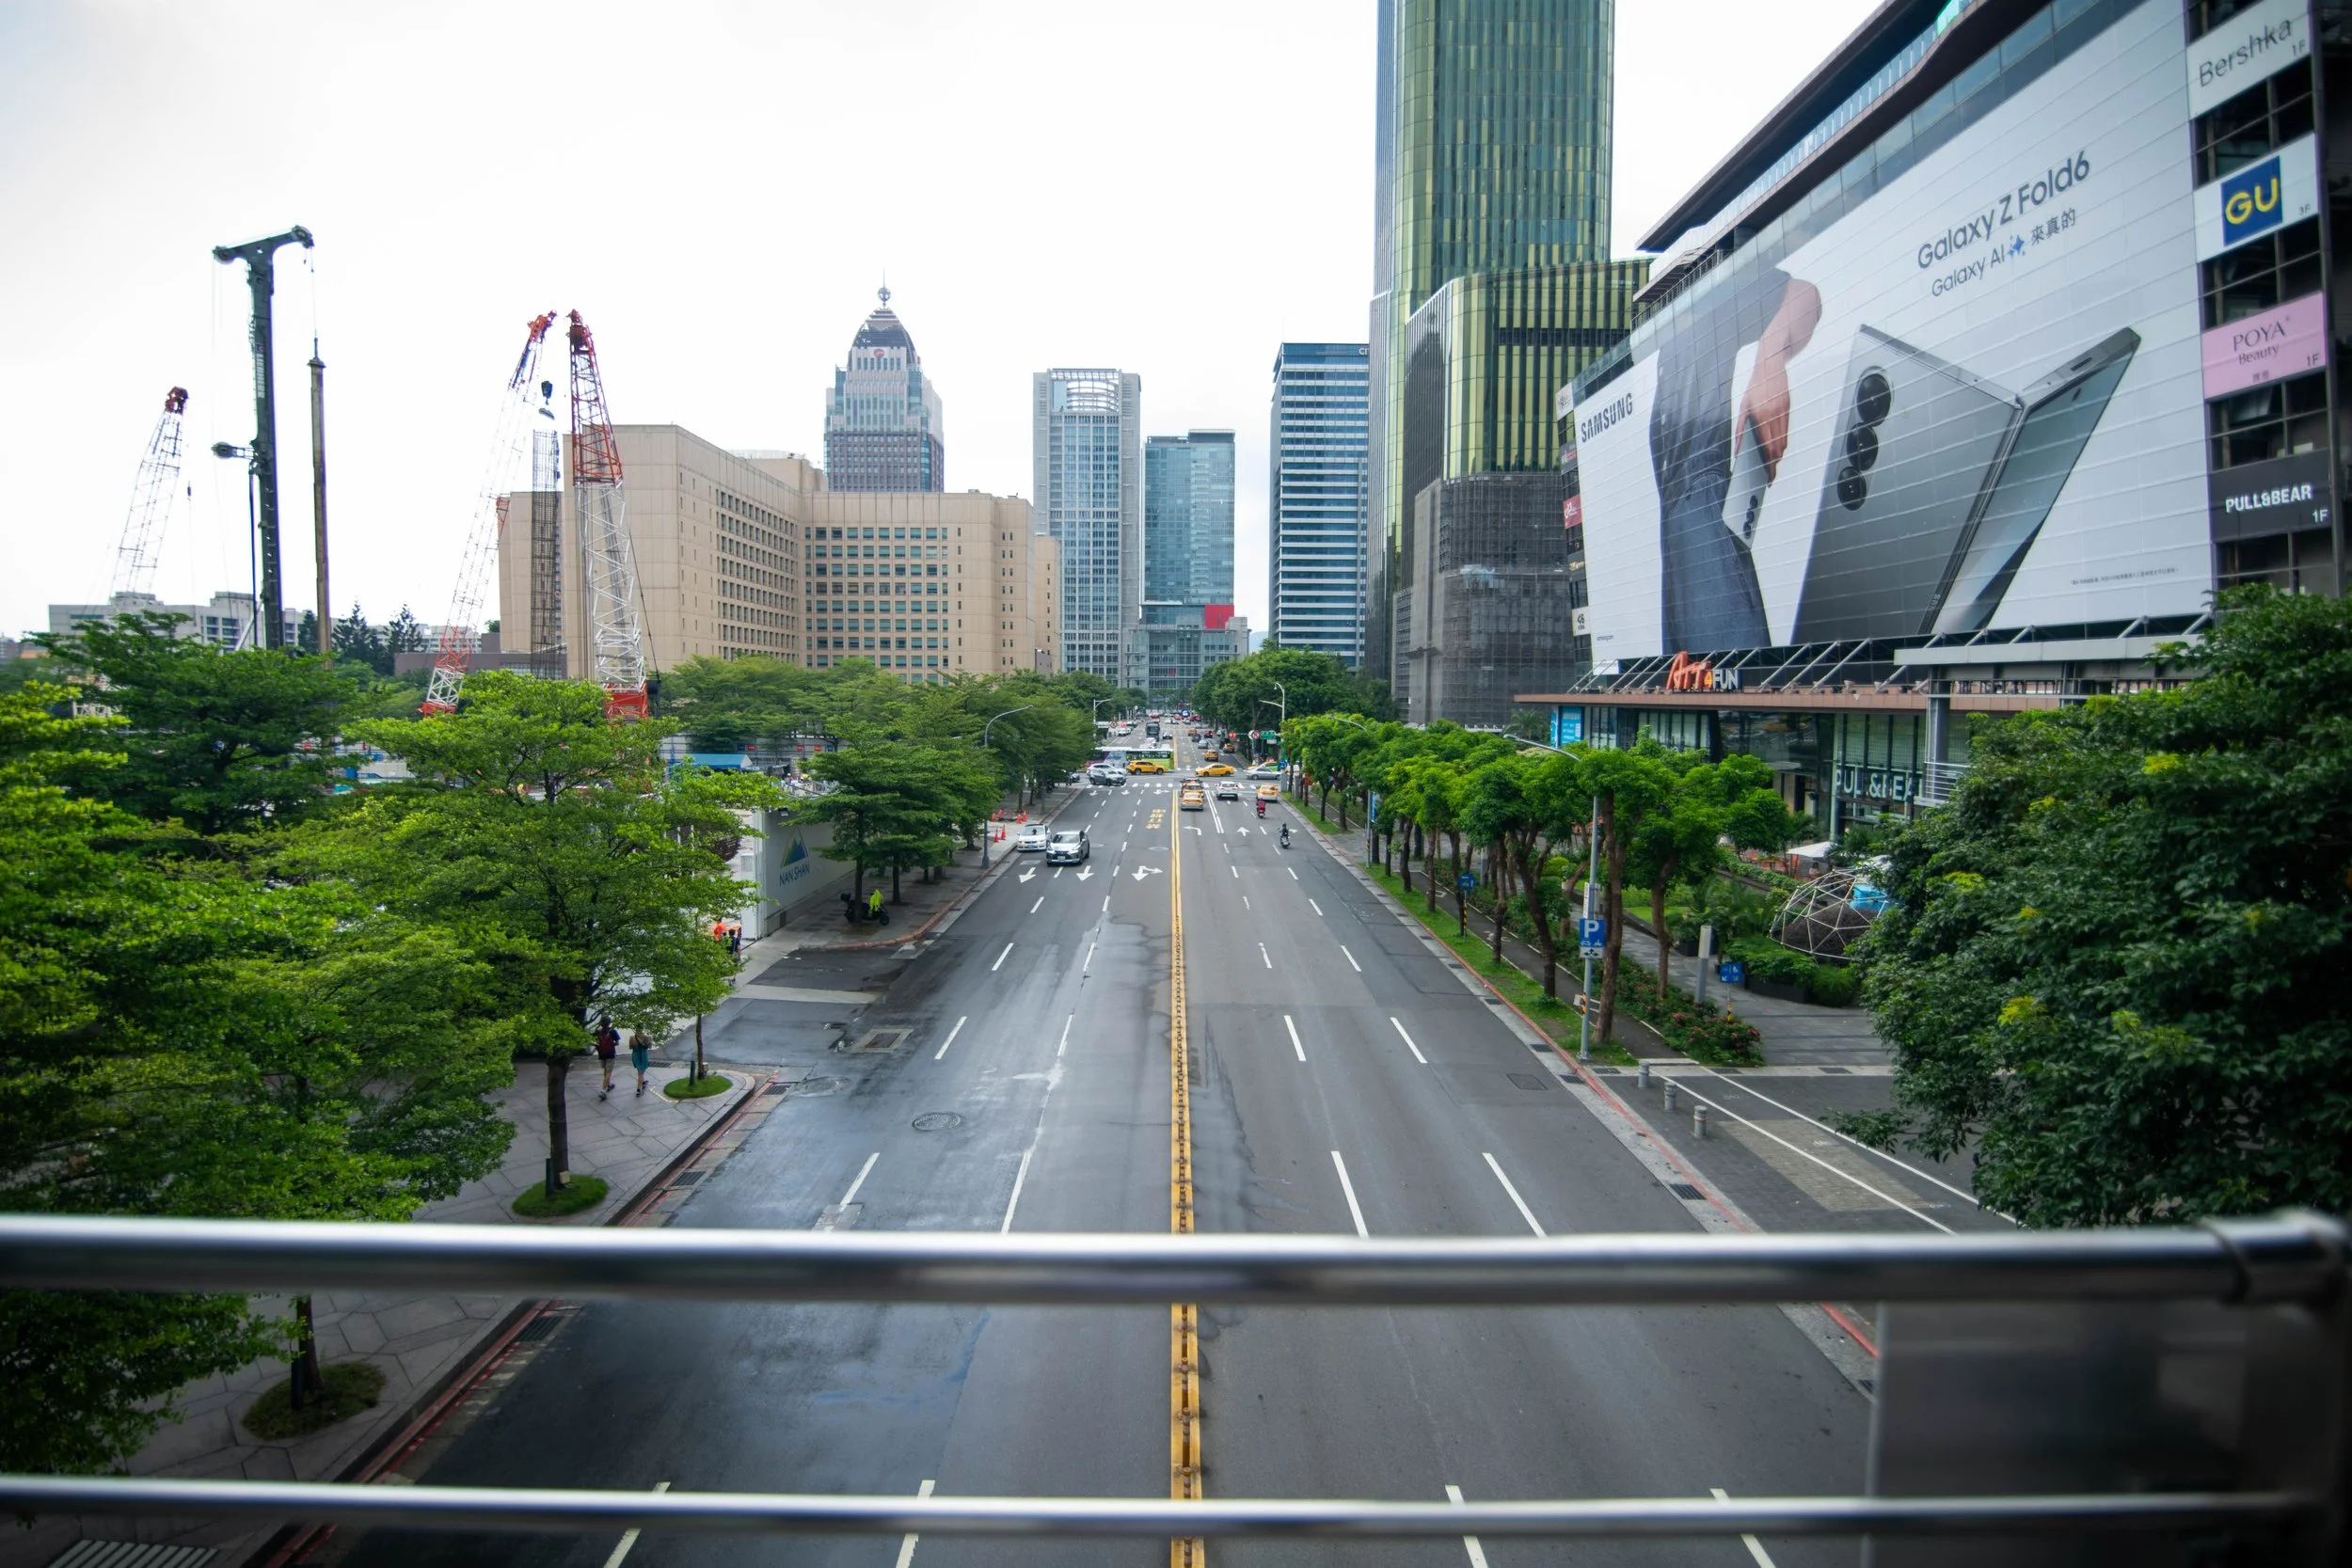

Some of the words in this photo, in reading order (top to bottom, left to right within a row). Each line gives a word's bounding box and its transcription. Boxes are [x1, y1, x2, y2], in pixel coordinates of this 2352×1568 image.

[2199, 19, 2292, 87] Bershka
[2291, 40, 2306, 56] 1F
[1917, 208, 1995, 270] Galaxy
[1998, 194, 2013, 226] Z
[2017, 150, 2090, 215] Fold6
[2225, 176, 2279, 225] GU
[2030, 207, 2076, 246] 來真的
[1931, 256, 1986, 297] Galaxy
[1990, 244, 2005, 269] AI
[2233, 320, 2286, 352] POYA
[2238, 343, 2280, 366] Beauty
[2306, 352, 2320, 367] 1F
[1581, 392, 1633, 444] SAMSUNG
[2224, 483, 2313, 514] PULL&BEAR
[2312, 508, 2328, 523] 1F
[1583, 920, 1600, 939] P
